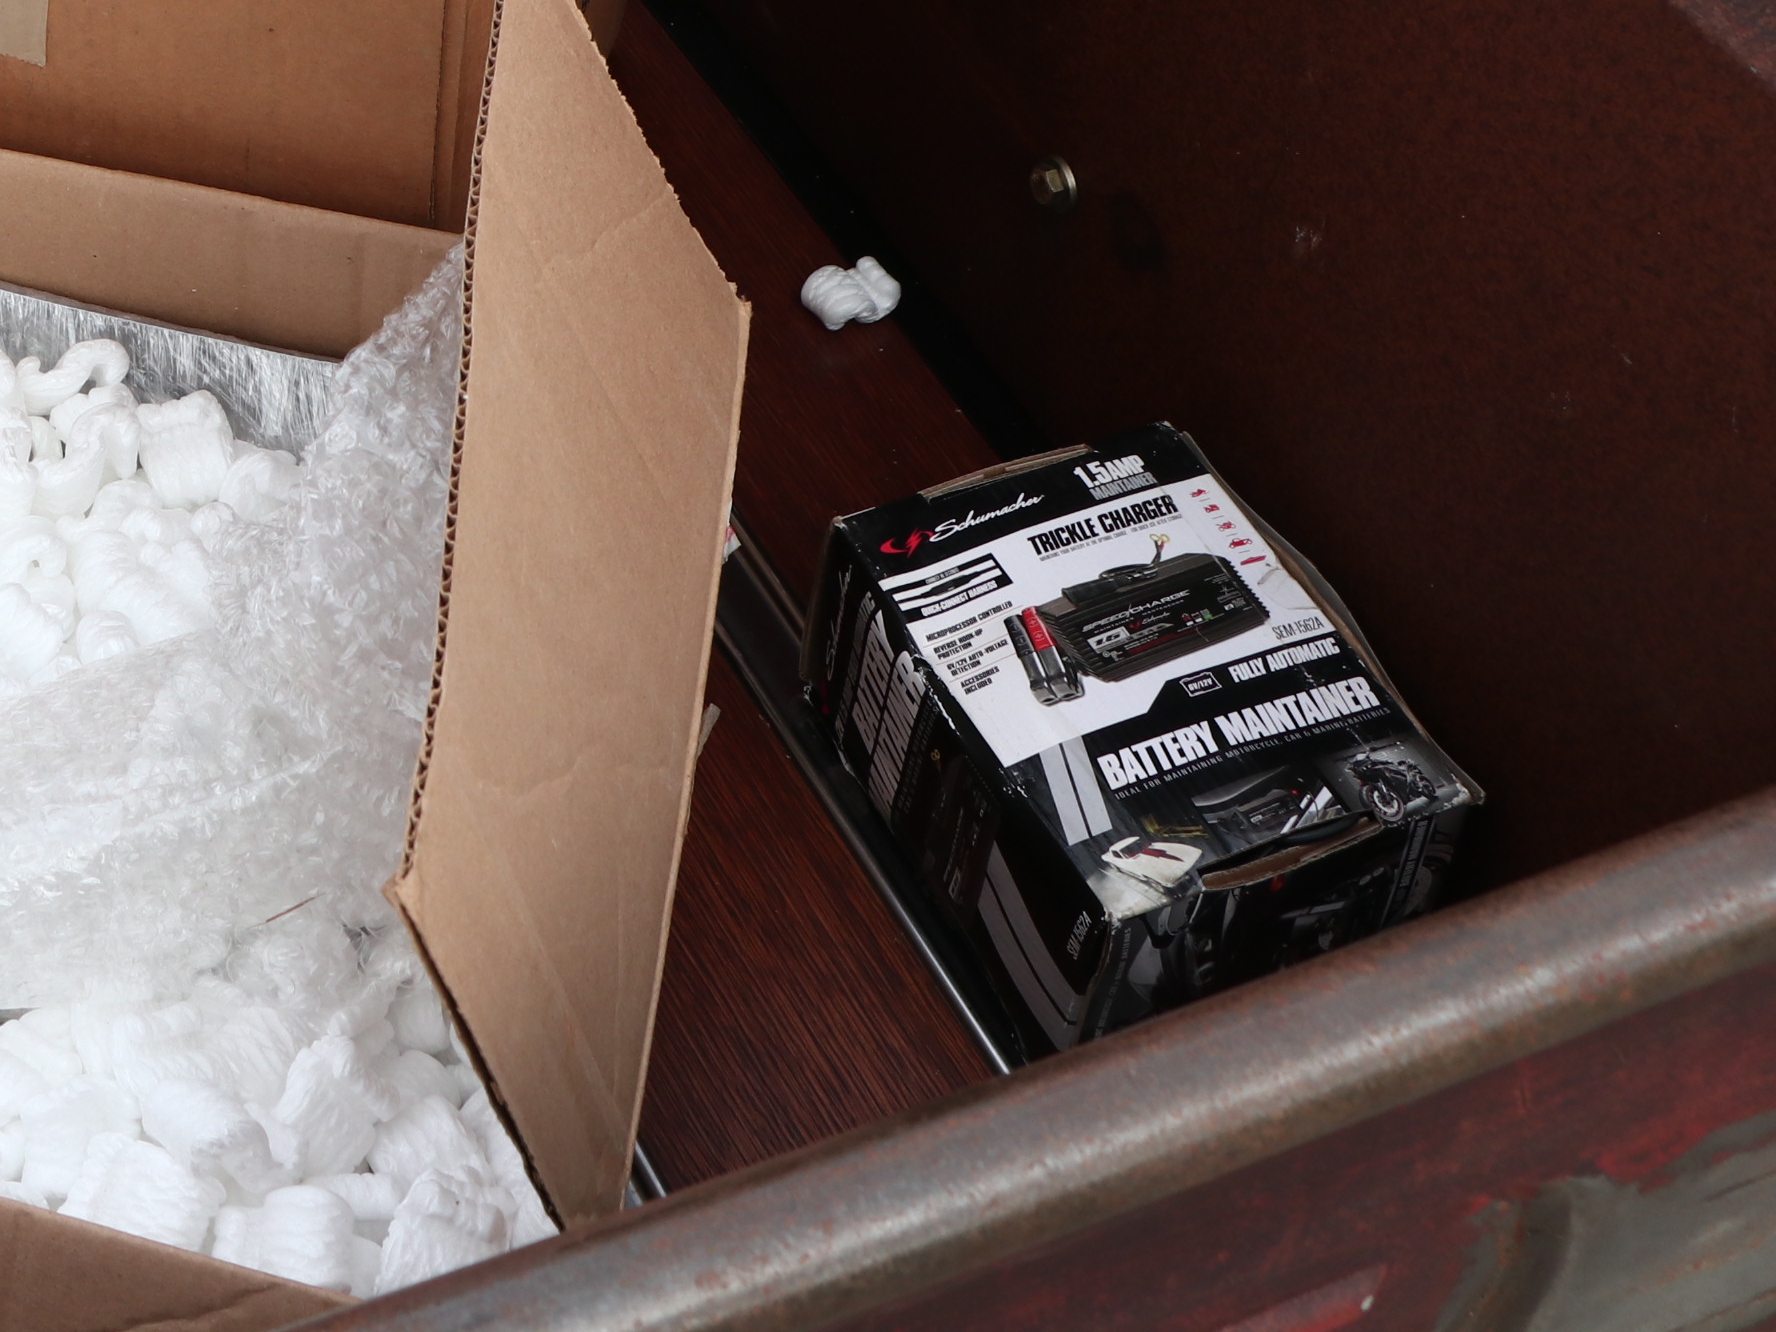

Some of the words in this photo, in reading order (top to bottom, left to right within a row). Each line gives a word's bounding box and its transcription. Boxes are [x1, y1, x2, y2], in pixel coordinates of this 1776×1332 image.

[1089, 472, 1158, 500] MAINTAINER
[929, 492, 1046, 542] Schumacher
[1027, 518, 1099, 555] TRICKLE
[1097, 494, 1179, 533] CHARGER
[926, 616, 977, 642] MICROPROCESSOR
[977, 601, 1013, 620] CONTROLLED
[1272, 617, 1325, 640] SEM-1562A
[933, 638, 957, 654] REVERSE
[958, 629, 983, 644] HOOK-UP
[937, 641, 972, 660] PROTECTION
[950, 660, 981, 676] DETECTION
[1228, 657, 1268, 683] FULLY
[1265, 638, 1340, 672] AUTOMATIC
[852, 609, 894, 755] BATTERY
[960, 666, 1000, 688] ACCESSORIES
[964, 678, 992, 695] INCLUDED
[1187, 678, 1213, 692] 6V/12V
[1096, 720, 1219, 791] BATTERY
[1214, 676, 1381, 746] MAINTAINER
[1114, 787, 1142, 800] IDEAL
[1143, 778, 1161, 790] FOR
[1163, 754, 1223, 782] MAINTAINING
[1284, 730, 1304, 743] CAR
